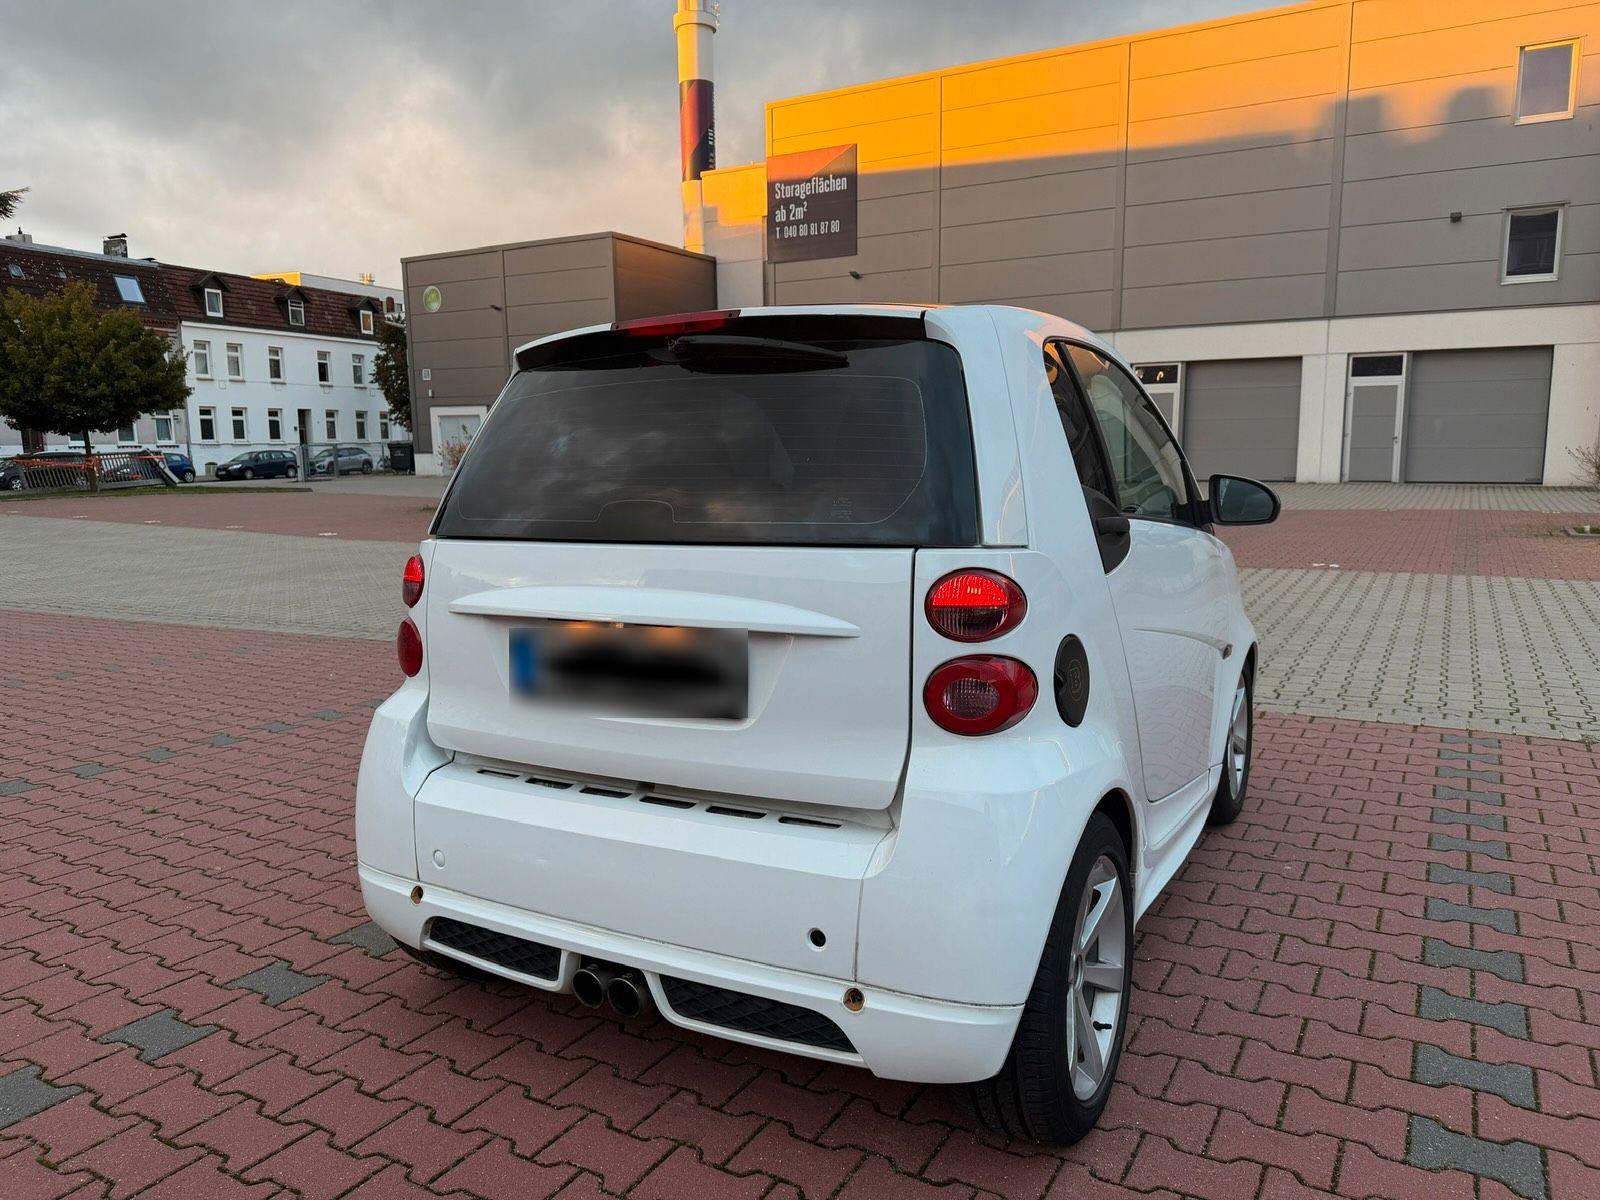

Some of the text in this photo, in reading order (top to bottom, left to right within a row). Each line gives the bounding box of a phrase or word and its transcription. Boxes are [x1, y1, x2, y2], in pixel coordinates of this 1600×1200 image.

[775, 174, 847, 199] Storageflächen
[775, 205, 786, 222] ab
[776, 220, 840, 239] T 040 80 81 87 80
